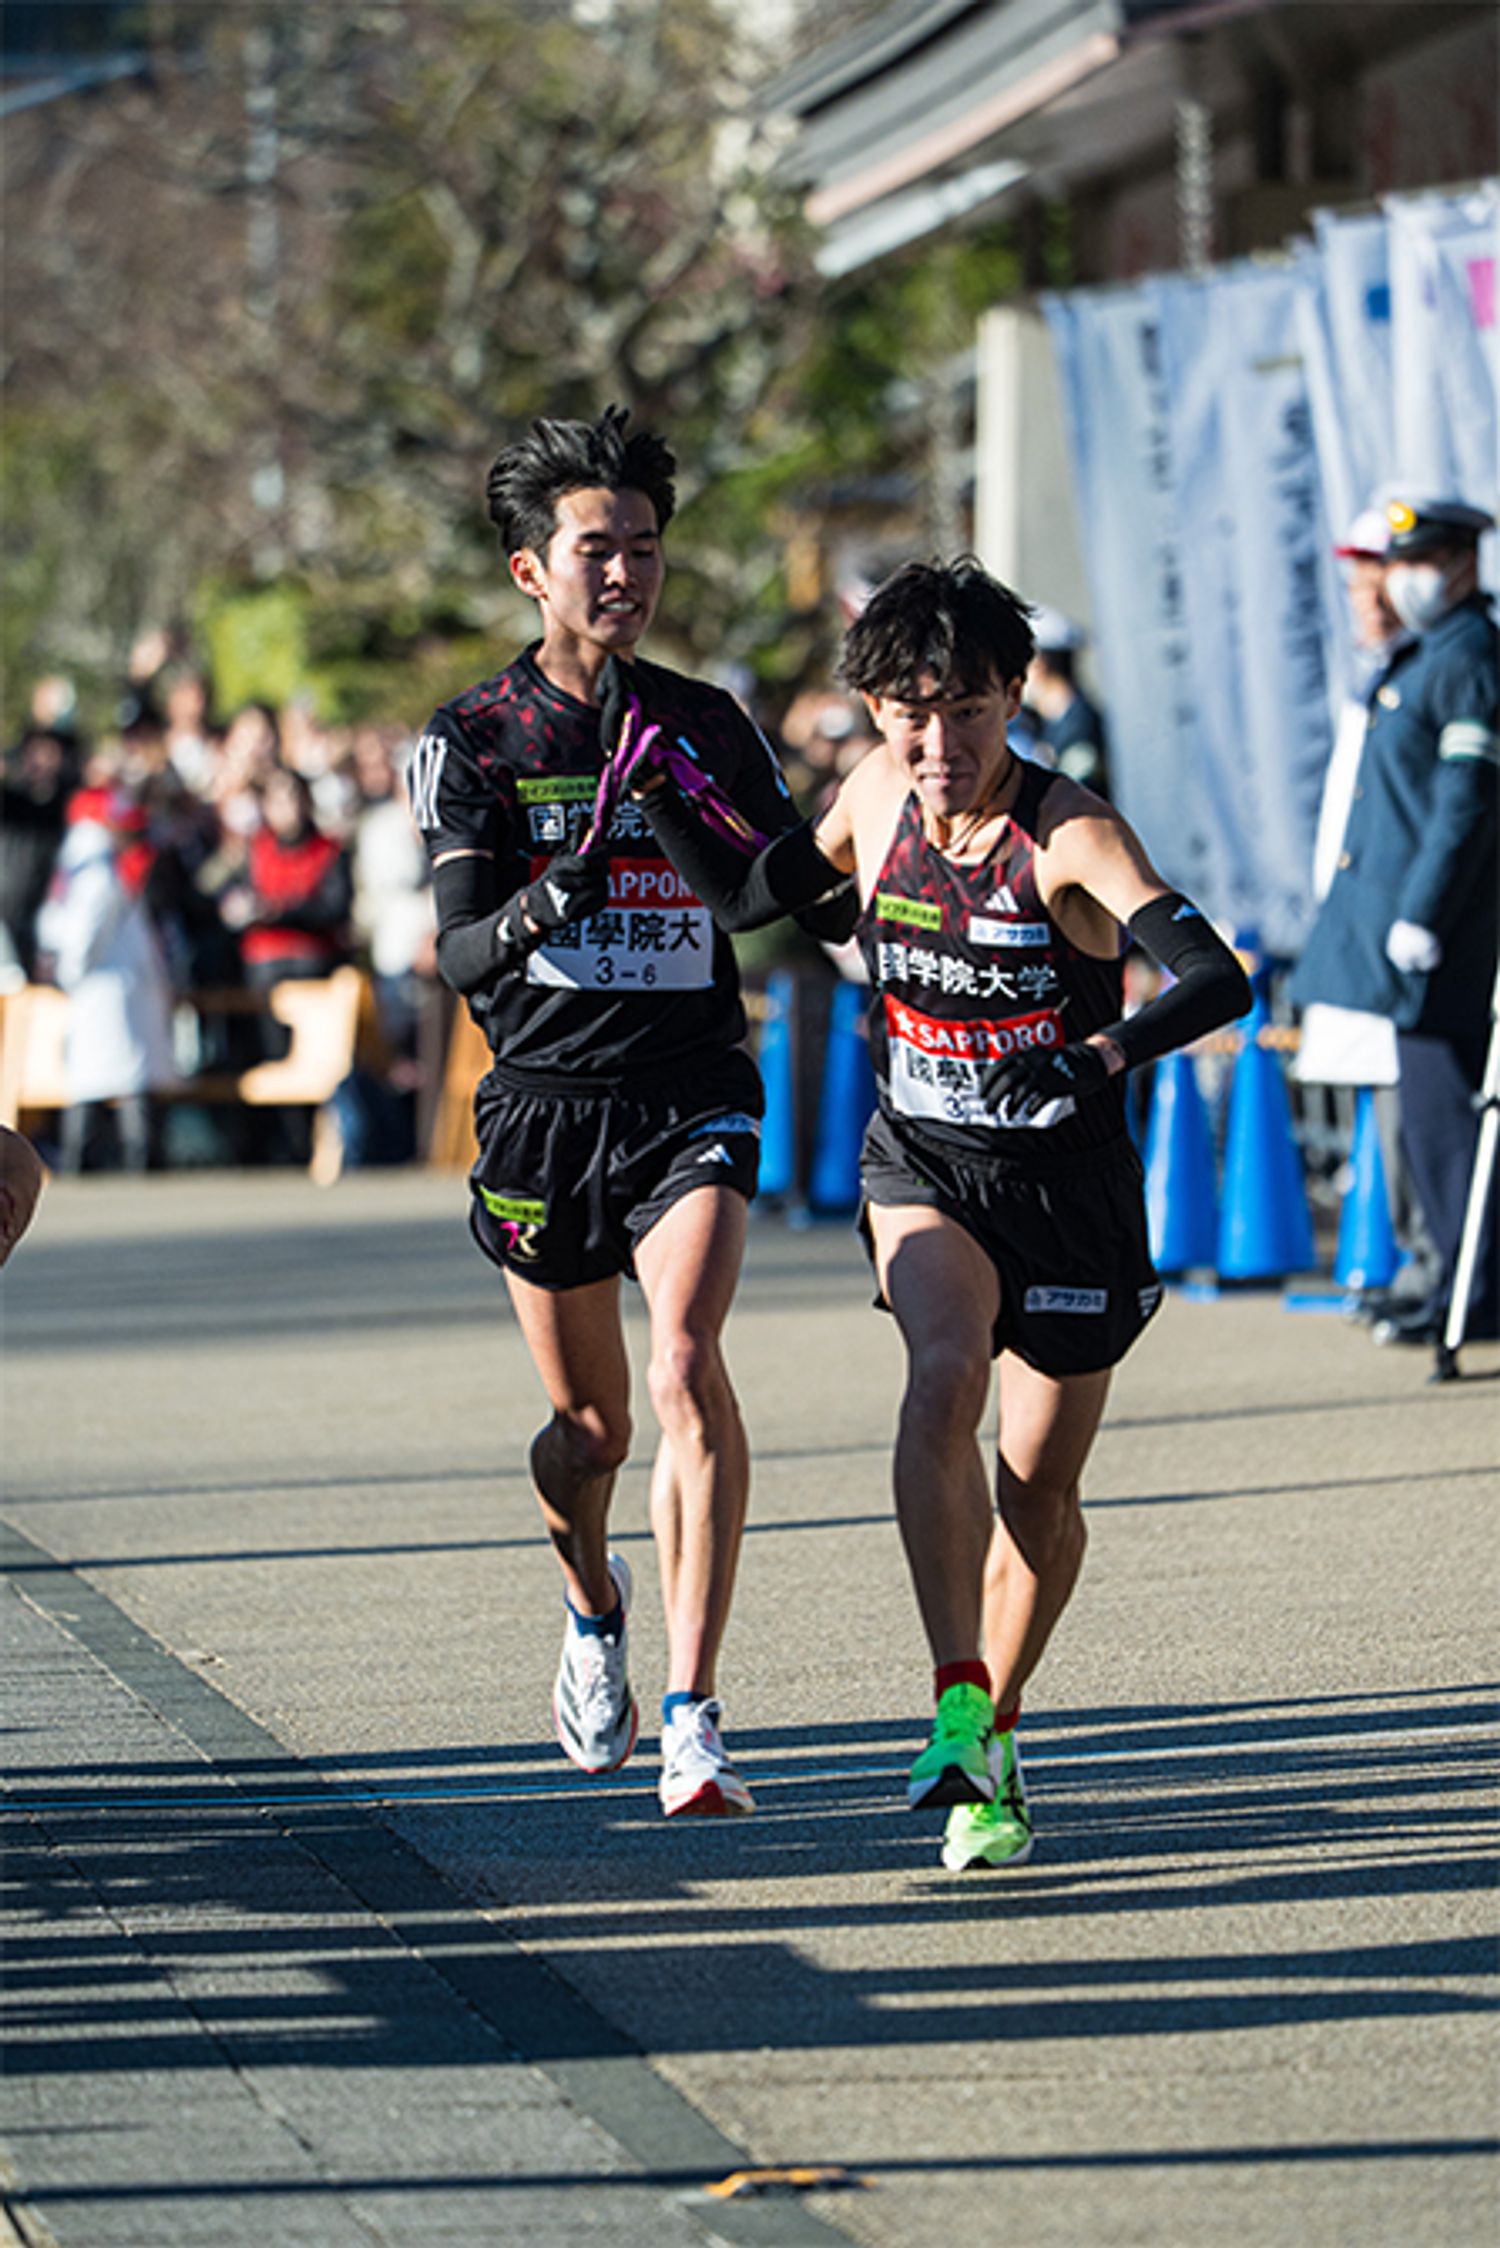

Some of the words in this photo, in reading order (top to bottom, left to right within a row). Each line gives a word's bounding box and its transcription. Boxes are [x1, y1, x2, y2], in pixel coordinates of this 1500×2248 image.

[877, 942, 1058, 999] 国学院大学
[917, 1019, 1056, 1054] SAPPORO
